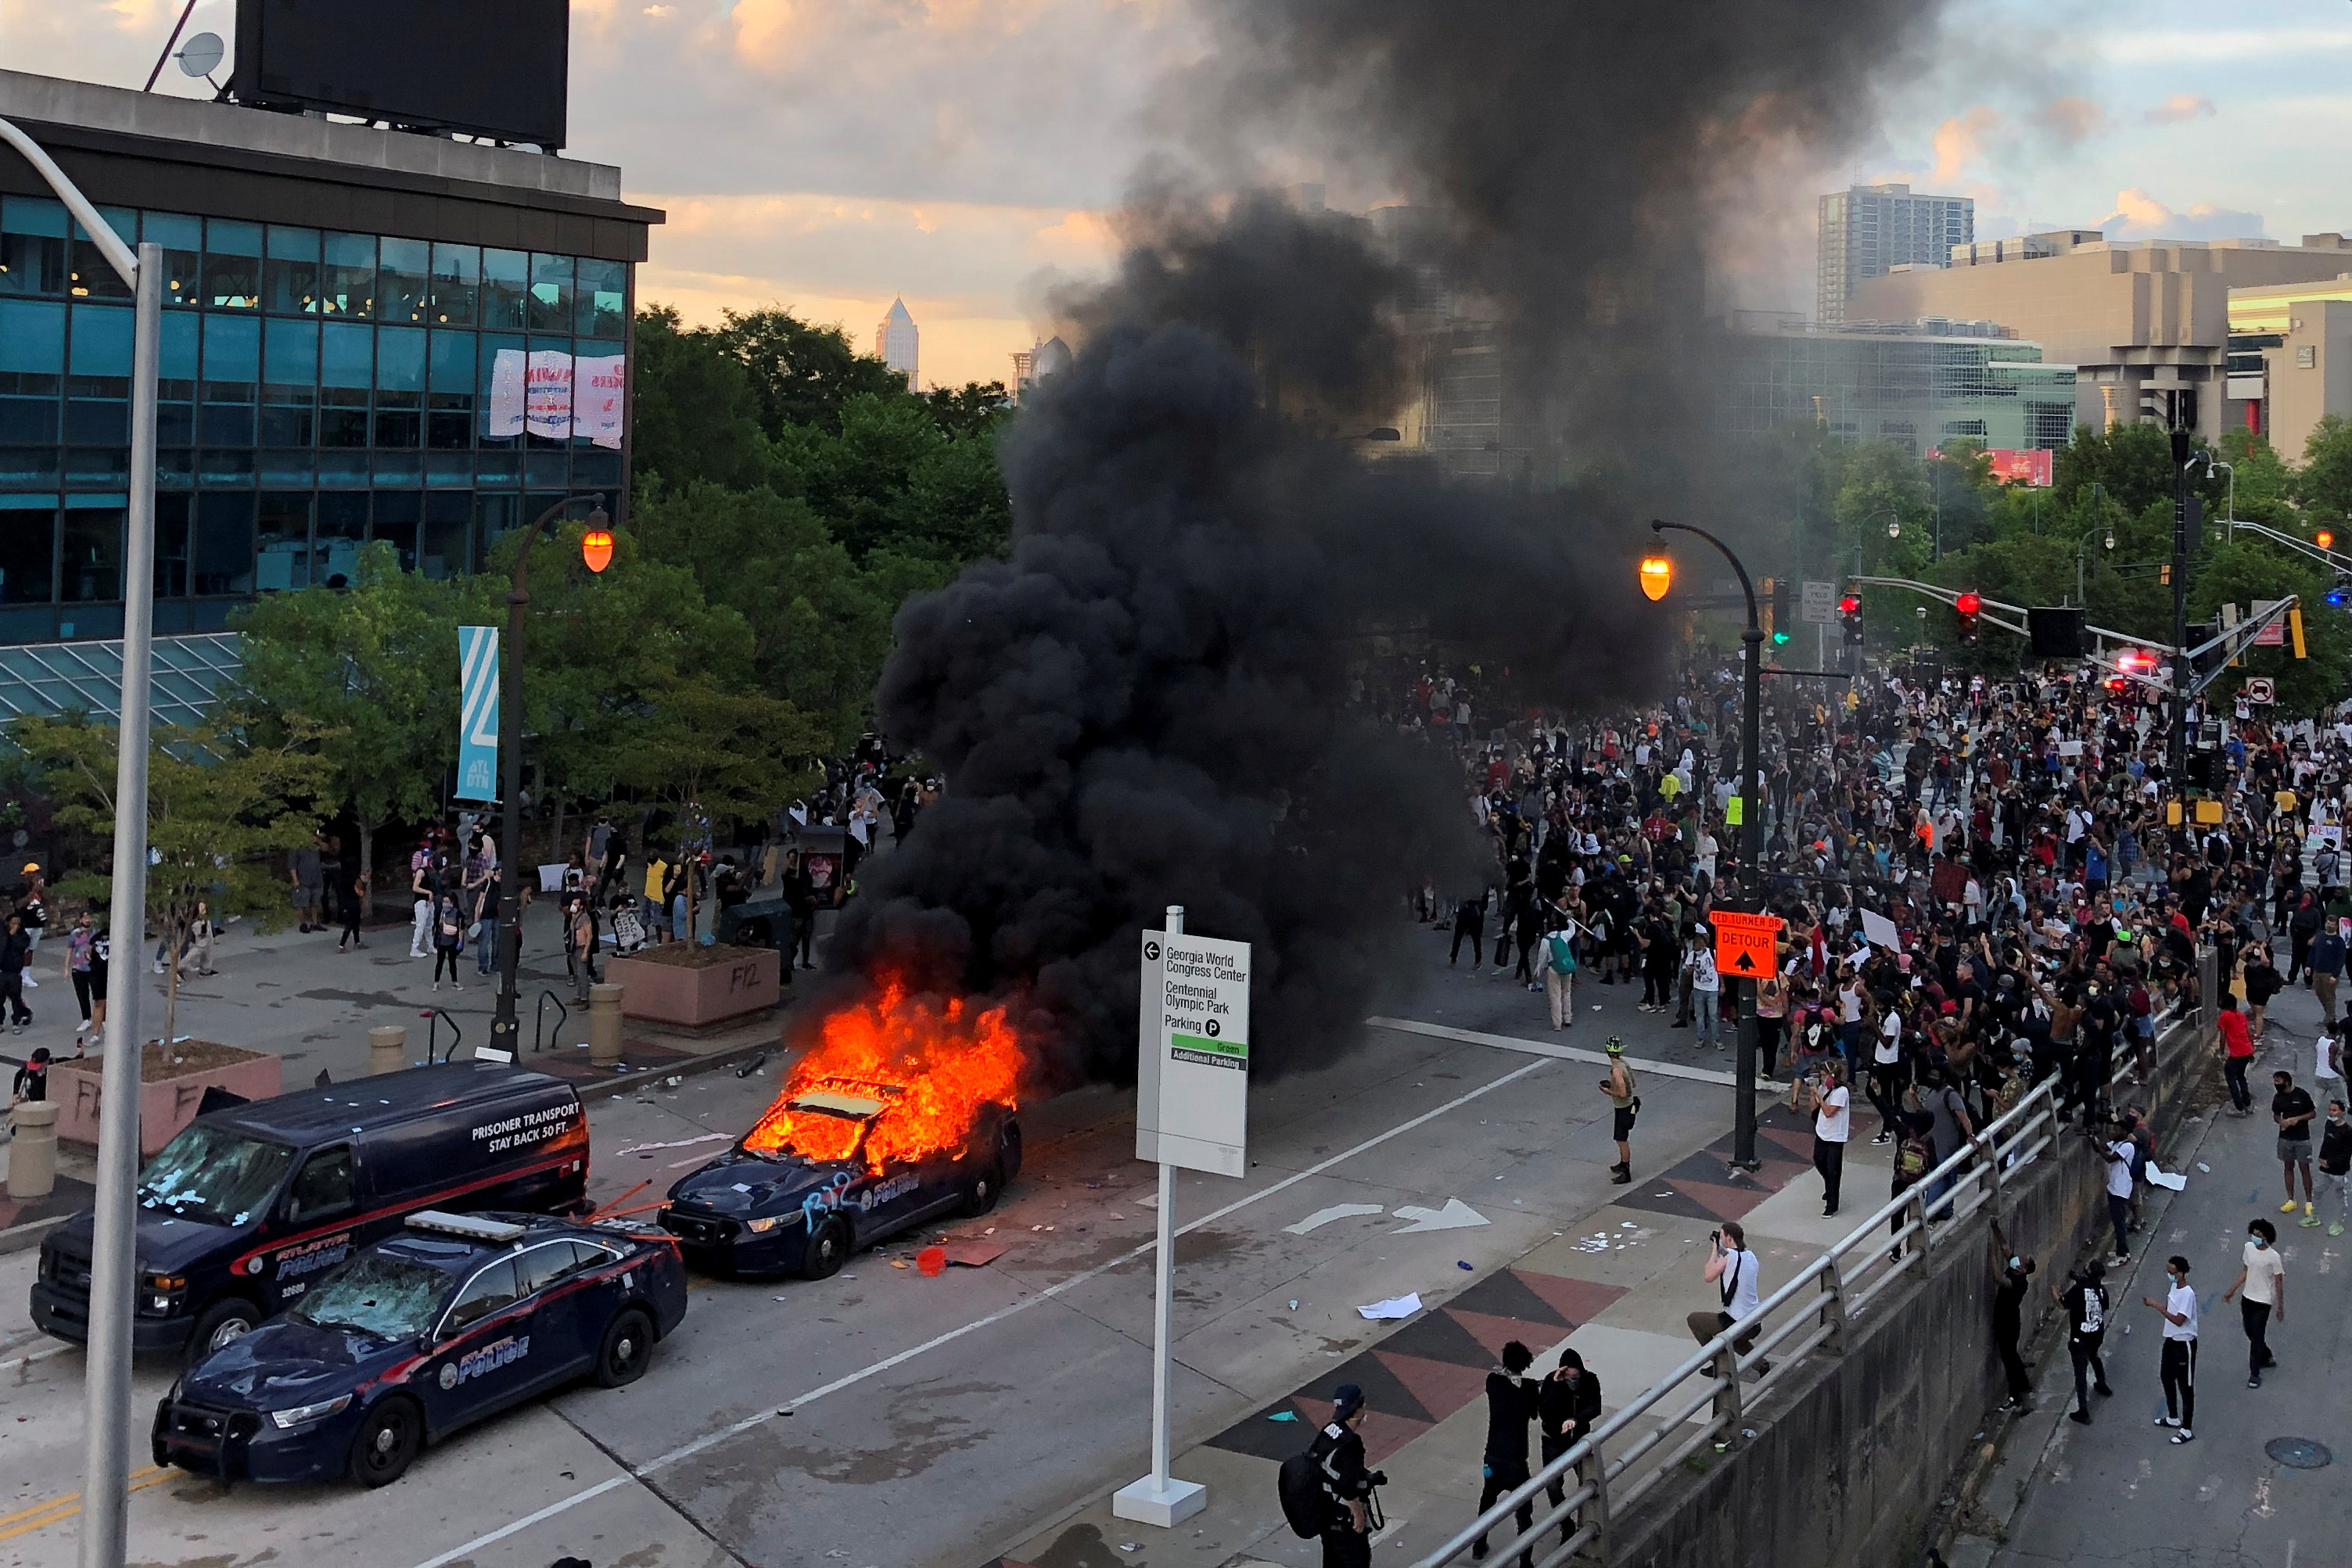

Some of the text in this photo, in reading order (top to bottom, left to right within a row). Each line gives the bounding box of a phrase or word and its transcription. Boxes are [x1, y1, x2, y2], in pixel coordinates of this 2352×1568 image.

[1711, 913, 1781, 929] TED TURNER DR
[1722, 932, 1769, 949] DETOUR
[1167, 947, 1233, 967] Georgia World
[1167, 960, 1246, 982] Congress Center
[1166, 981, 1216, 999] Centennial
[1165, 994, 1230, 1014] Olympic Park
[1165, 1014, 1201, 1034] Parking
[1217, 1042, 1240, 1054] Green
[1173, 1050, 1240, 1070] Additional Parking
[472, 1102, 580, 1140] PRISONER TRANSPORT
[489, 1121, 569, 1153] STAY BACK 50 FT.
[873, 1175, 920, 1207] POLICE
[276, 1243, 350, 1281] POLICE
[458, 1336, 530, 1385] POLICE
